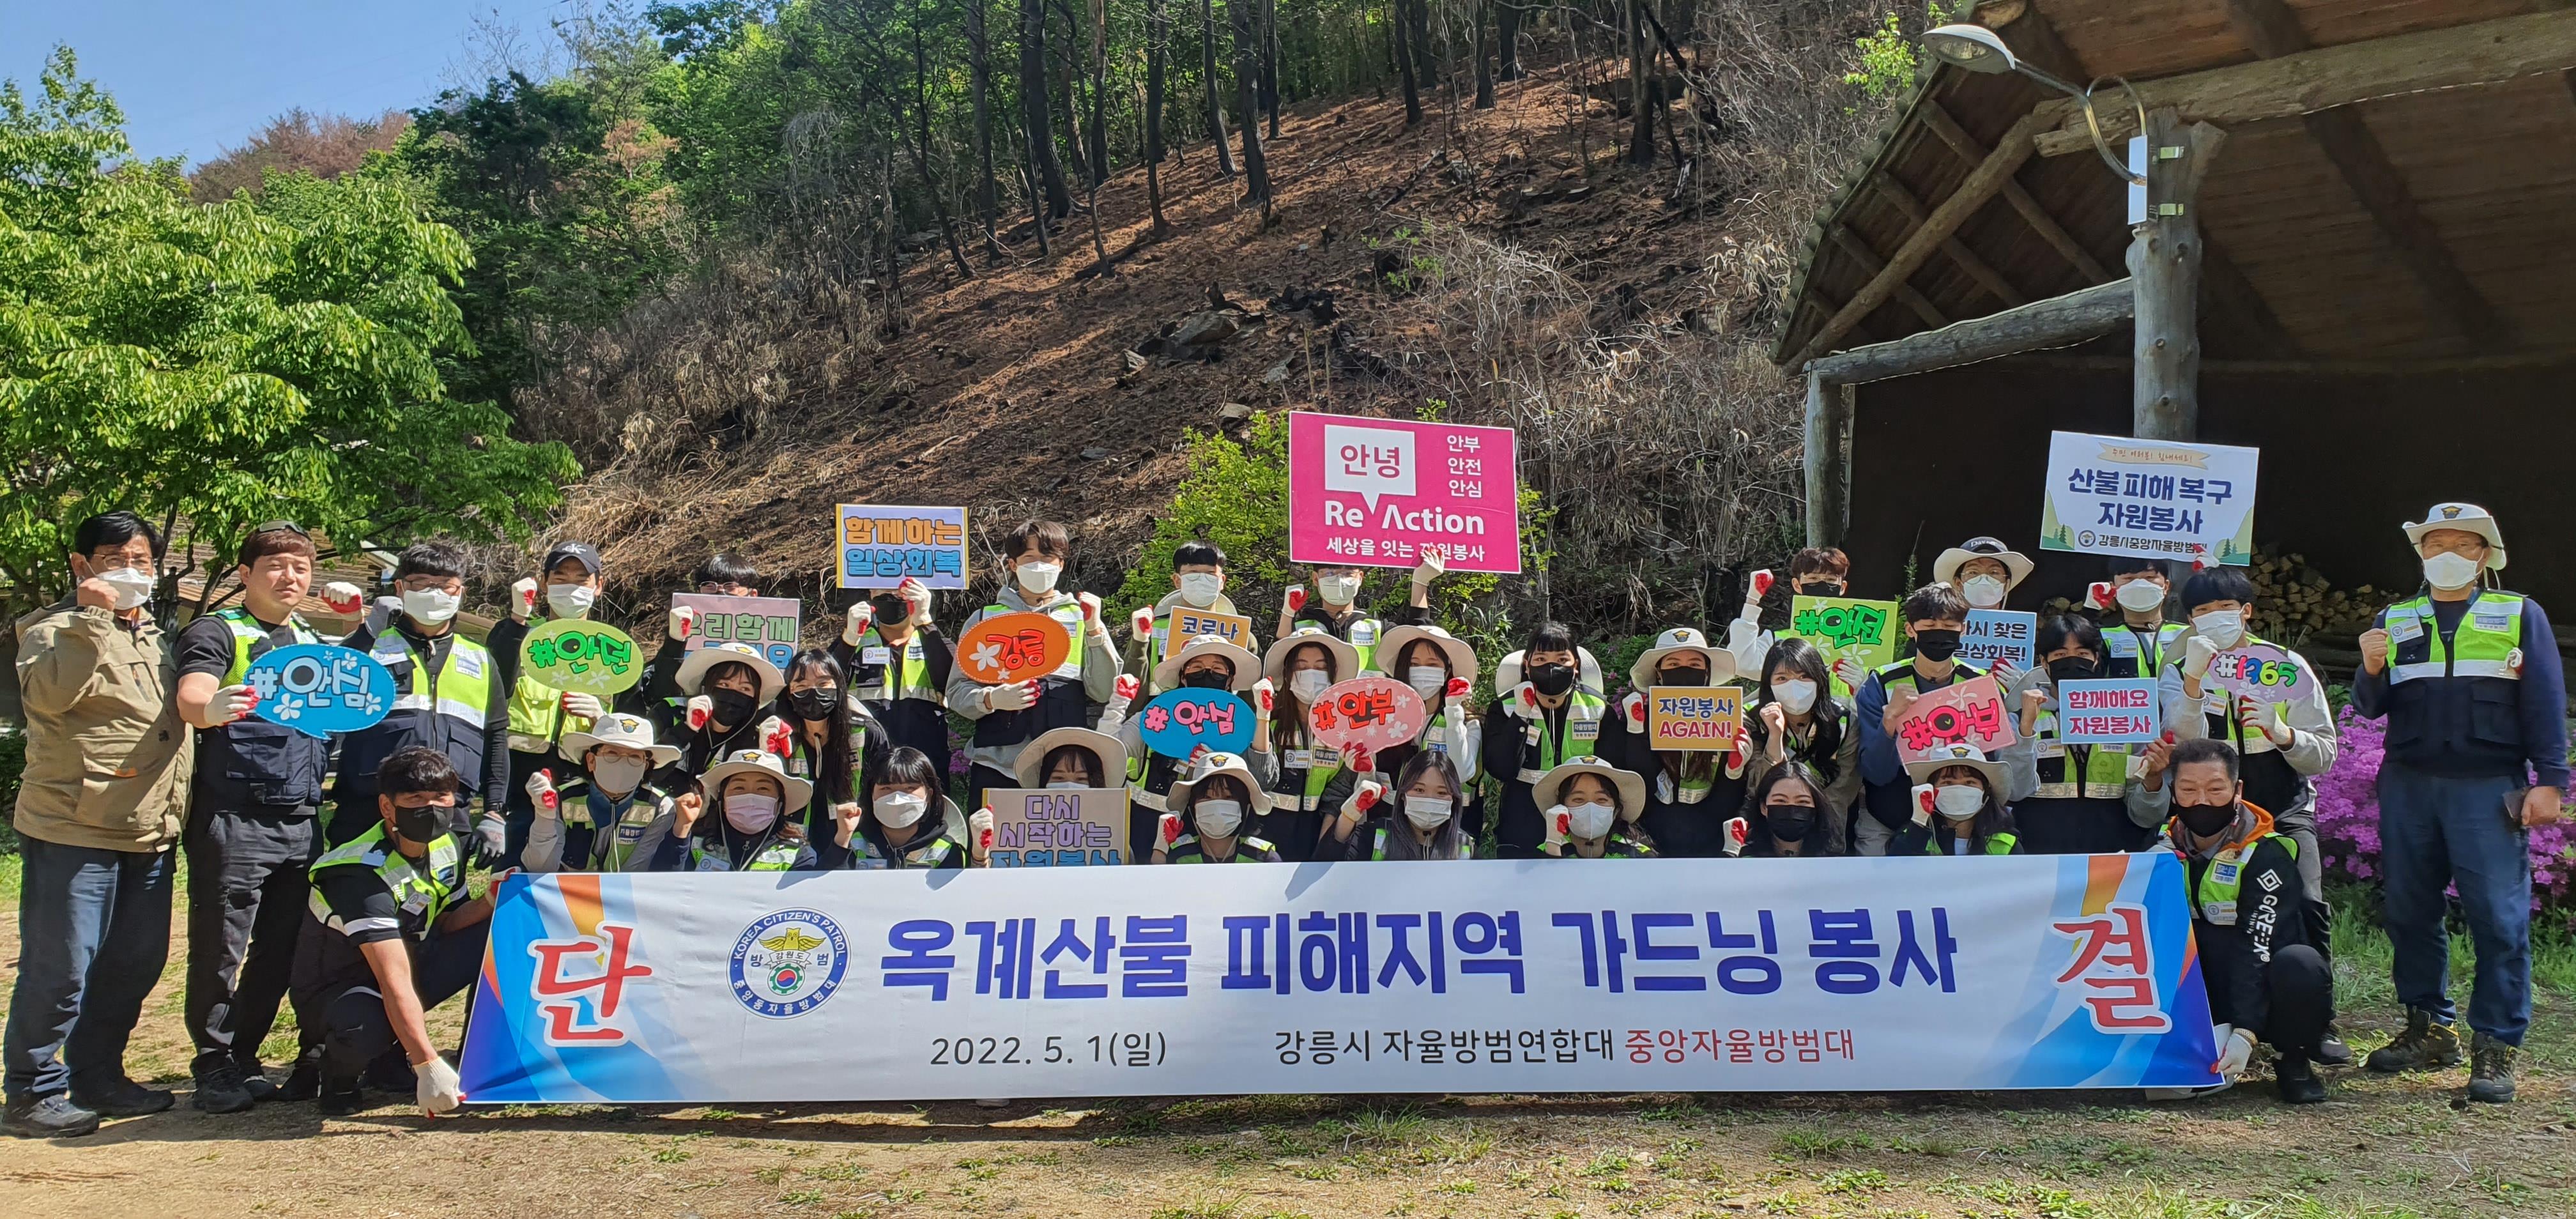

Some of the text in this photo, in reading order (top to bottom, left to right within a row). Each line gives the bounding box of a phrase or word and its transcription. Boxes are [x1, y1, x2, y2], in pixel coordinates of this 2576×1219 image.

[1447, 435, 1480, 453] 안부
[1340, 445, 1400, 478] 안녕
[1448, 458, 1482, 476] 안전
[1448, 480, 1482, 498] 안심
[2068, 468, 2232, 504] 산불 피해 복구
[1325, 501, 1363, 527] Re
[2097, 502, 2203, 534] 자원봉사
[844, 516, 962, 545] 함께하는
[1327, 537, 1376, 555] 세상을
[1381, 540, 1414, 557] 잇는
[846, 548, 962, 578] 일상회복
[1181, 616, 1239, 640] 코로나
[1793, 604, 1887, 649] #안전
[1993, 622, 2027, 639] 찾은
[528, 631, 632, 675] #안전
[986, 629, 1045, 670] 강릉
[249, 656, 371, 709] #안심
[2214, 654, 2299, 687] #1365
[1337, 688, 1395, 730] 안부
[1659, 697, 1734, 719] 자원봉사
[2067, 689, 2149, 709] 함께해요
[1173, 700, 1236, 735] 안심
[1659, 721, 1732, 739] AGAIN!
[1901, 698, 2000, 751] #안부
[2069, 716, 2151, 735] 자원봉사
[1025, 795, 1080, 820] 다시
[999, 822, 1112, 848] 시작하는
[734, 912, 846, 960] KOREA CITIZEN'S PATROL
[751, 953, 829, 967] 방 범
[776, 951, 804, 960] 강원도
[882, 907, 1958, 1001] 옥계산불 피해지역 가드닝 봉사
[2053, 907, 2166, 1028] 결
[533, 924, 652, 1041] 단
[930, 1036, 1032, 1065] 2022.
[1087, 1031, 1167, 1067] 1(일)
[1274, 1028, 1855, 1065] 강릉시 자율방범연합대 중앙자율방범대
